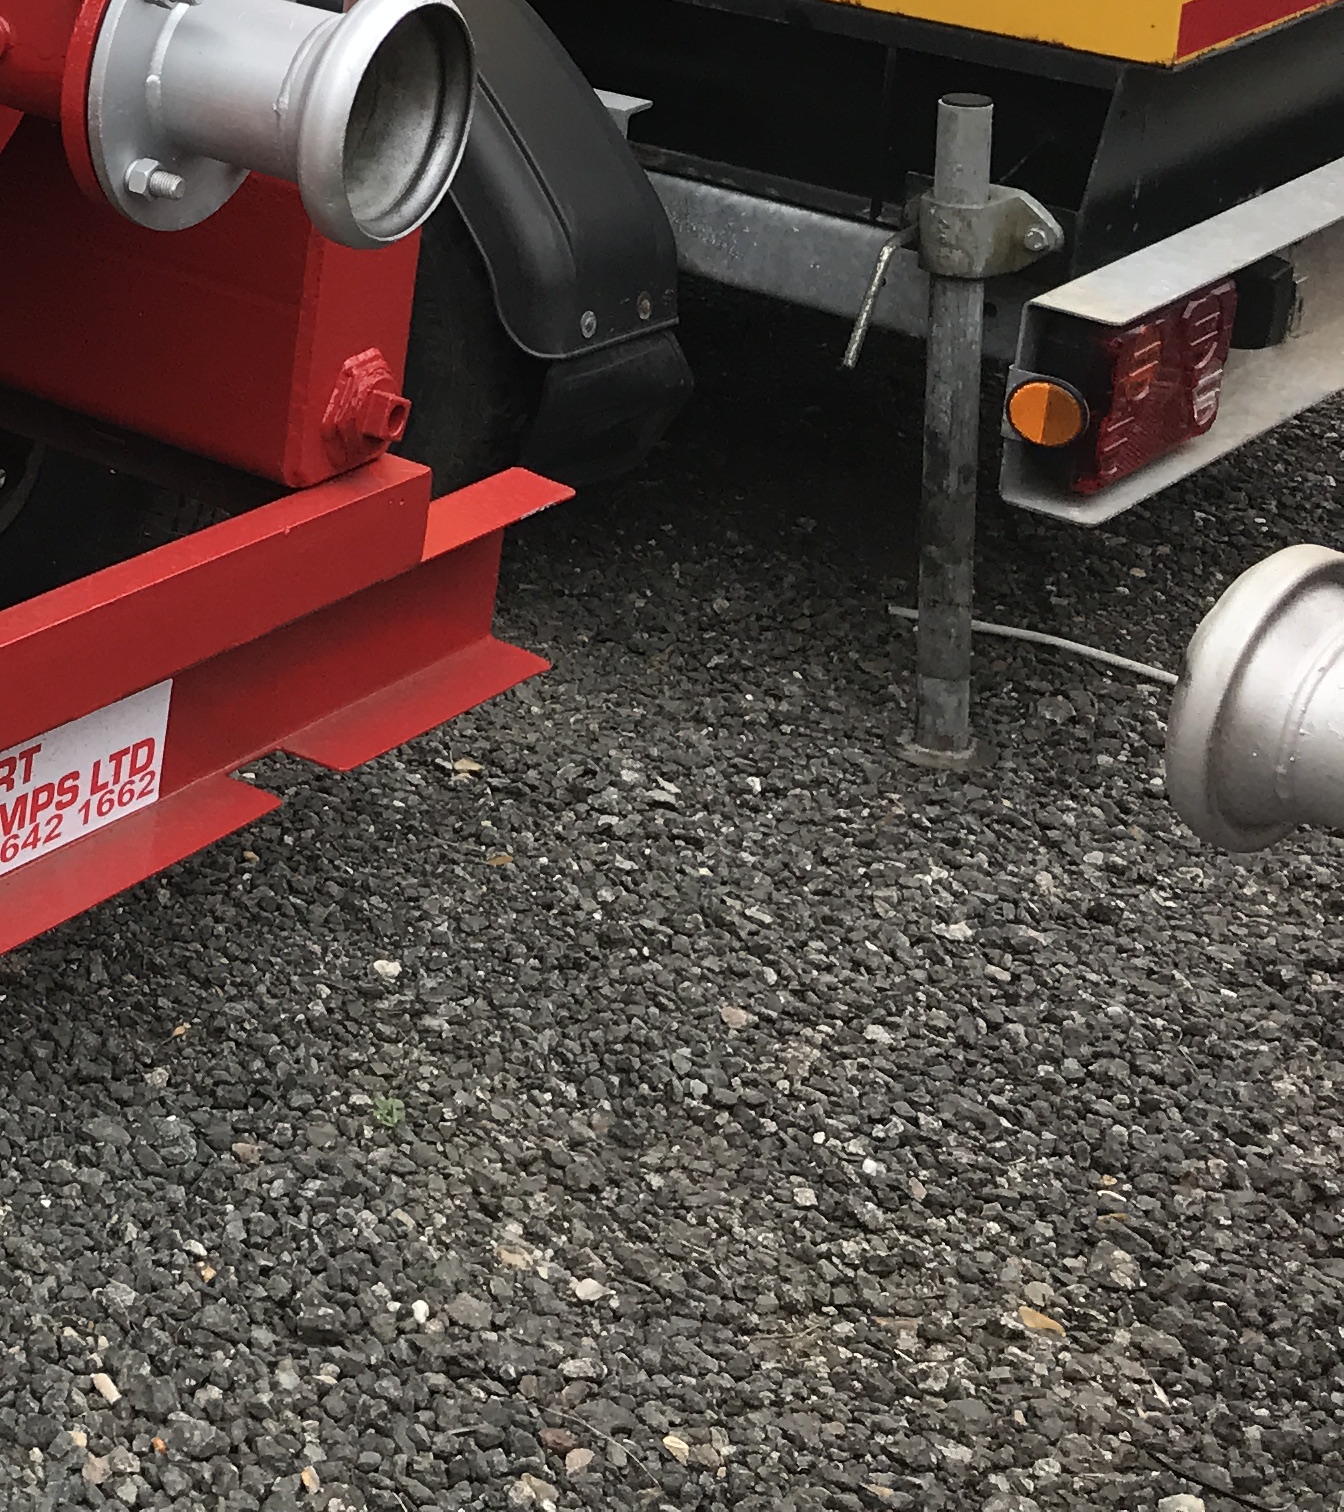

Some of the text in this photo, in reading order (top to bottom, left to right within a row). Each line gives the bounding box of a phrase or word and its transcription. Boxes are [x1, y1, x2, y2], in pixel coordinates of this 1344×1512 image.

[91, 736, 156, 796] LTD
[0, 813, 63, 864] 642
[78, 769, 157, 825] 1662
